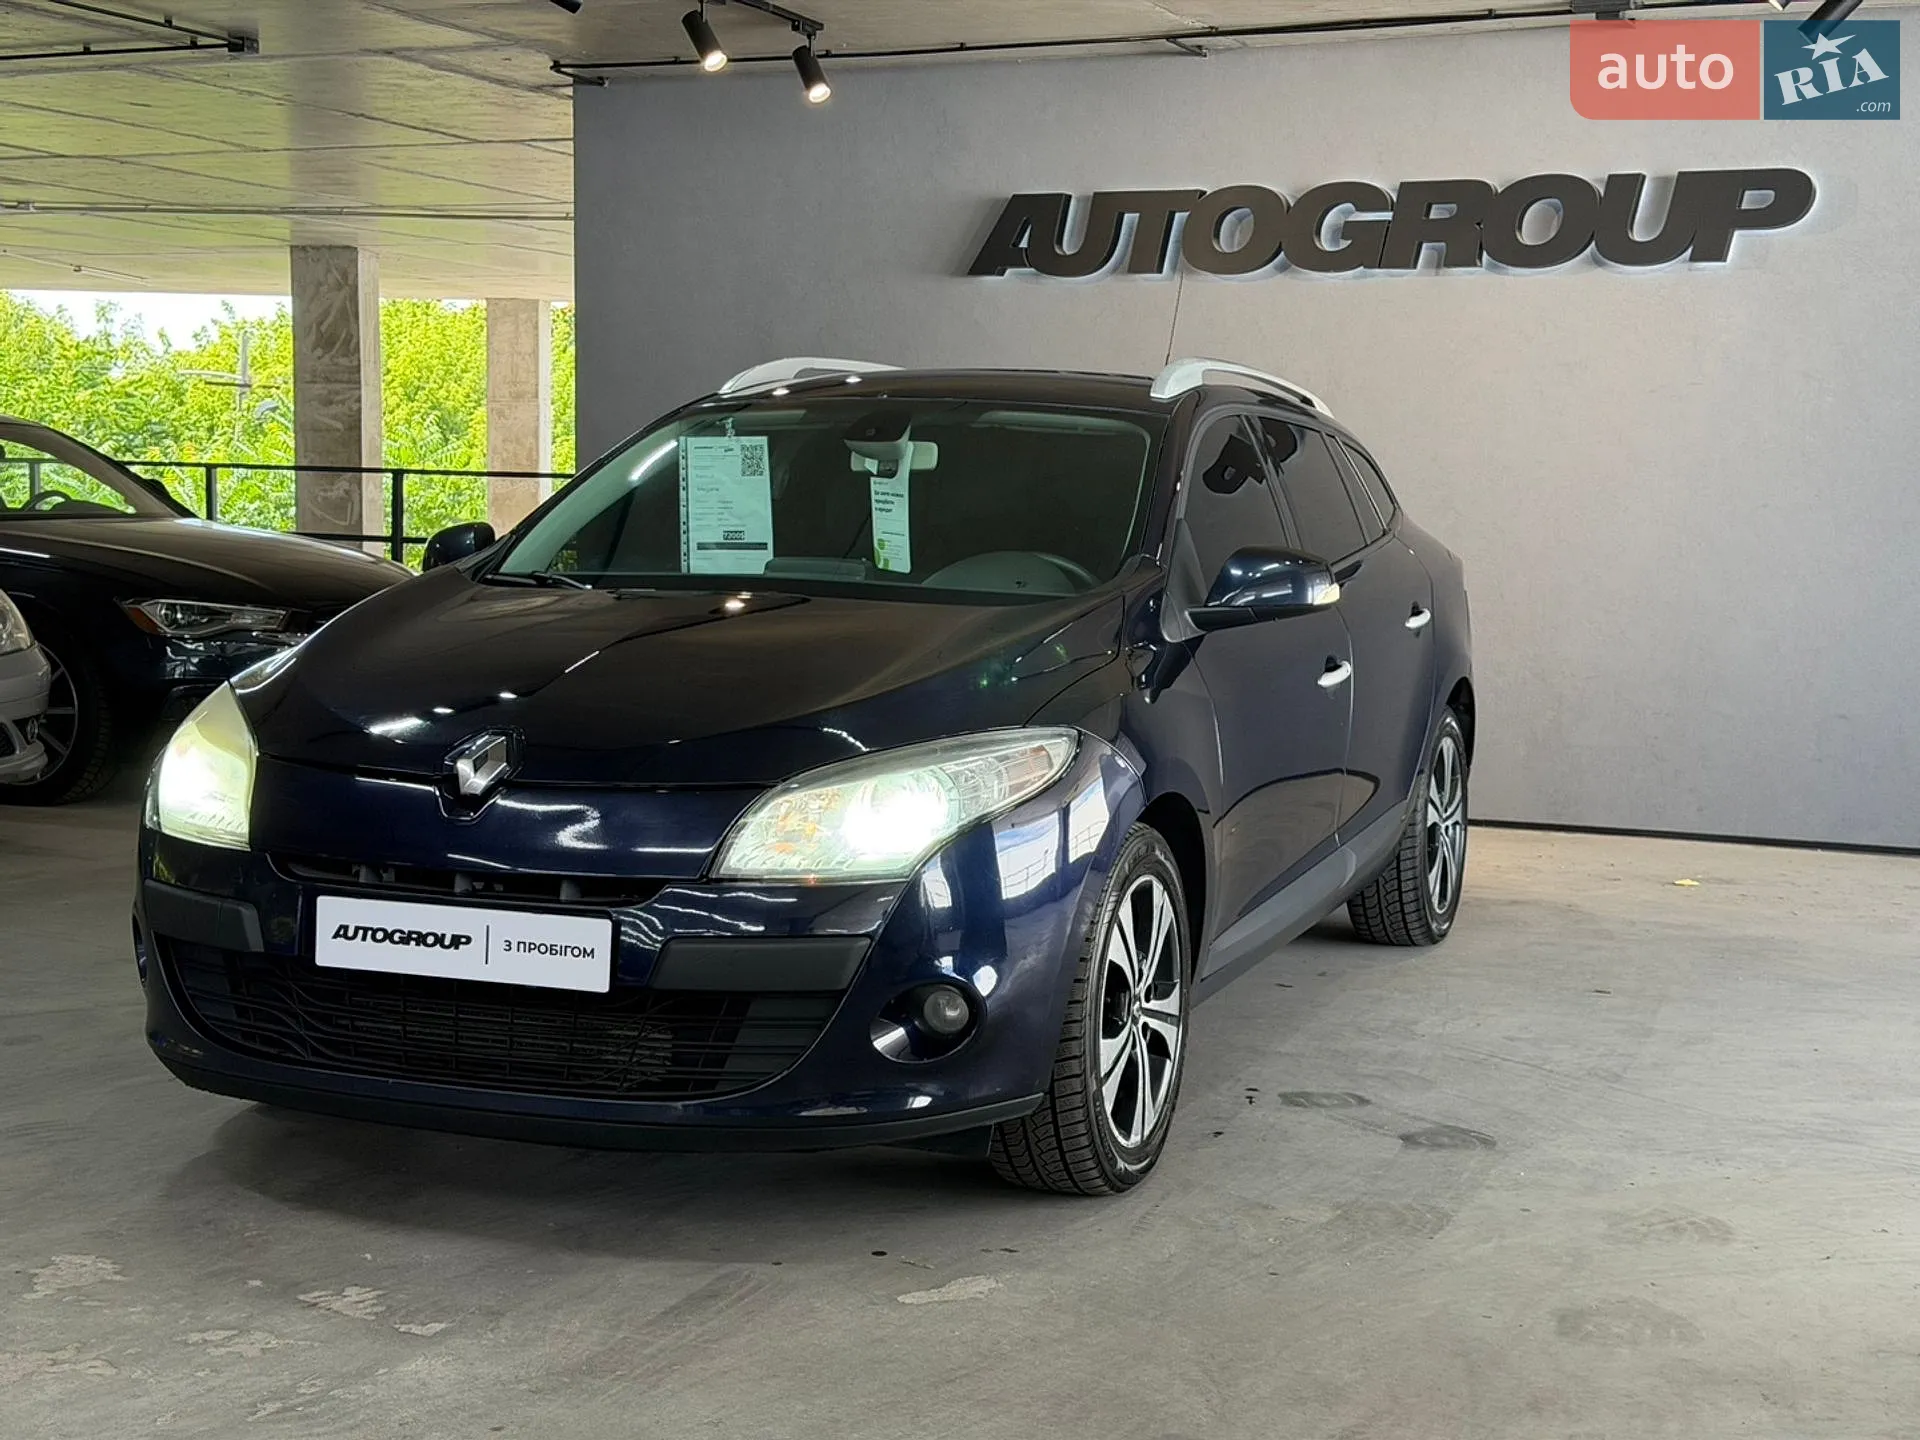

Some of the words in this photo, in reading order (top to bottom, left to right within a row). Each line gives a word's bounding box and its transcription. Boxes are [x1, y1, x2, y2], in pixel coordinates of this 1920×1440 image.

[968, 167, 1817, 277] AUTOGROUP
[332, 924, 473, 951] AUTOGROUP
[516, 940, 595, 960] ПРОБІГОМ
